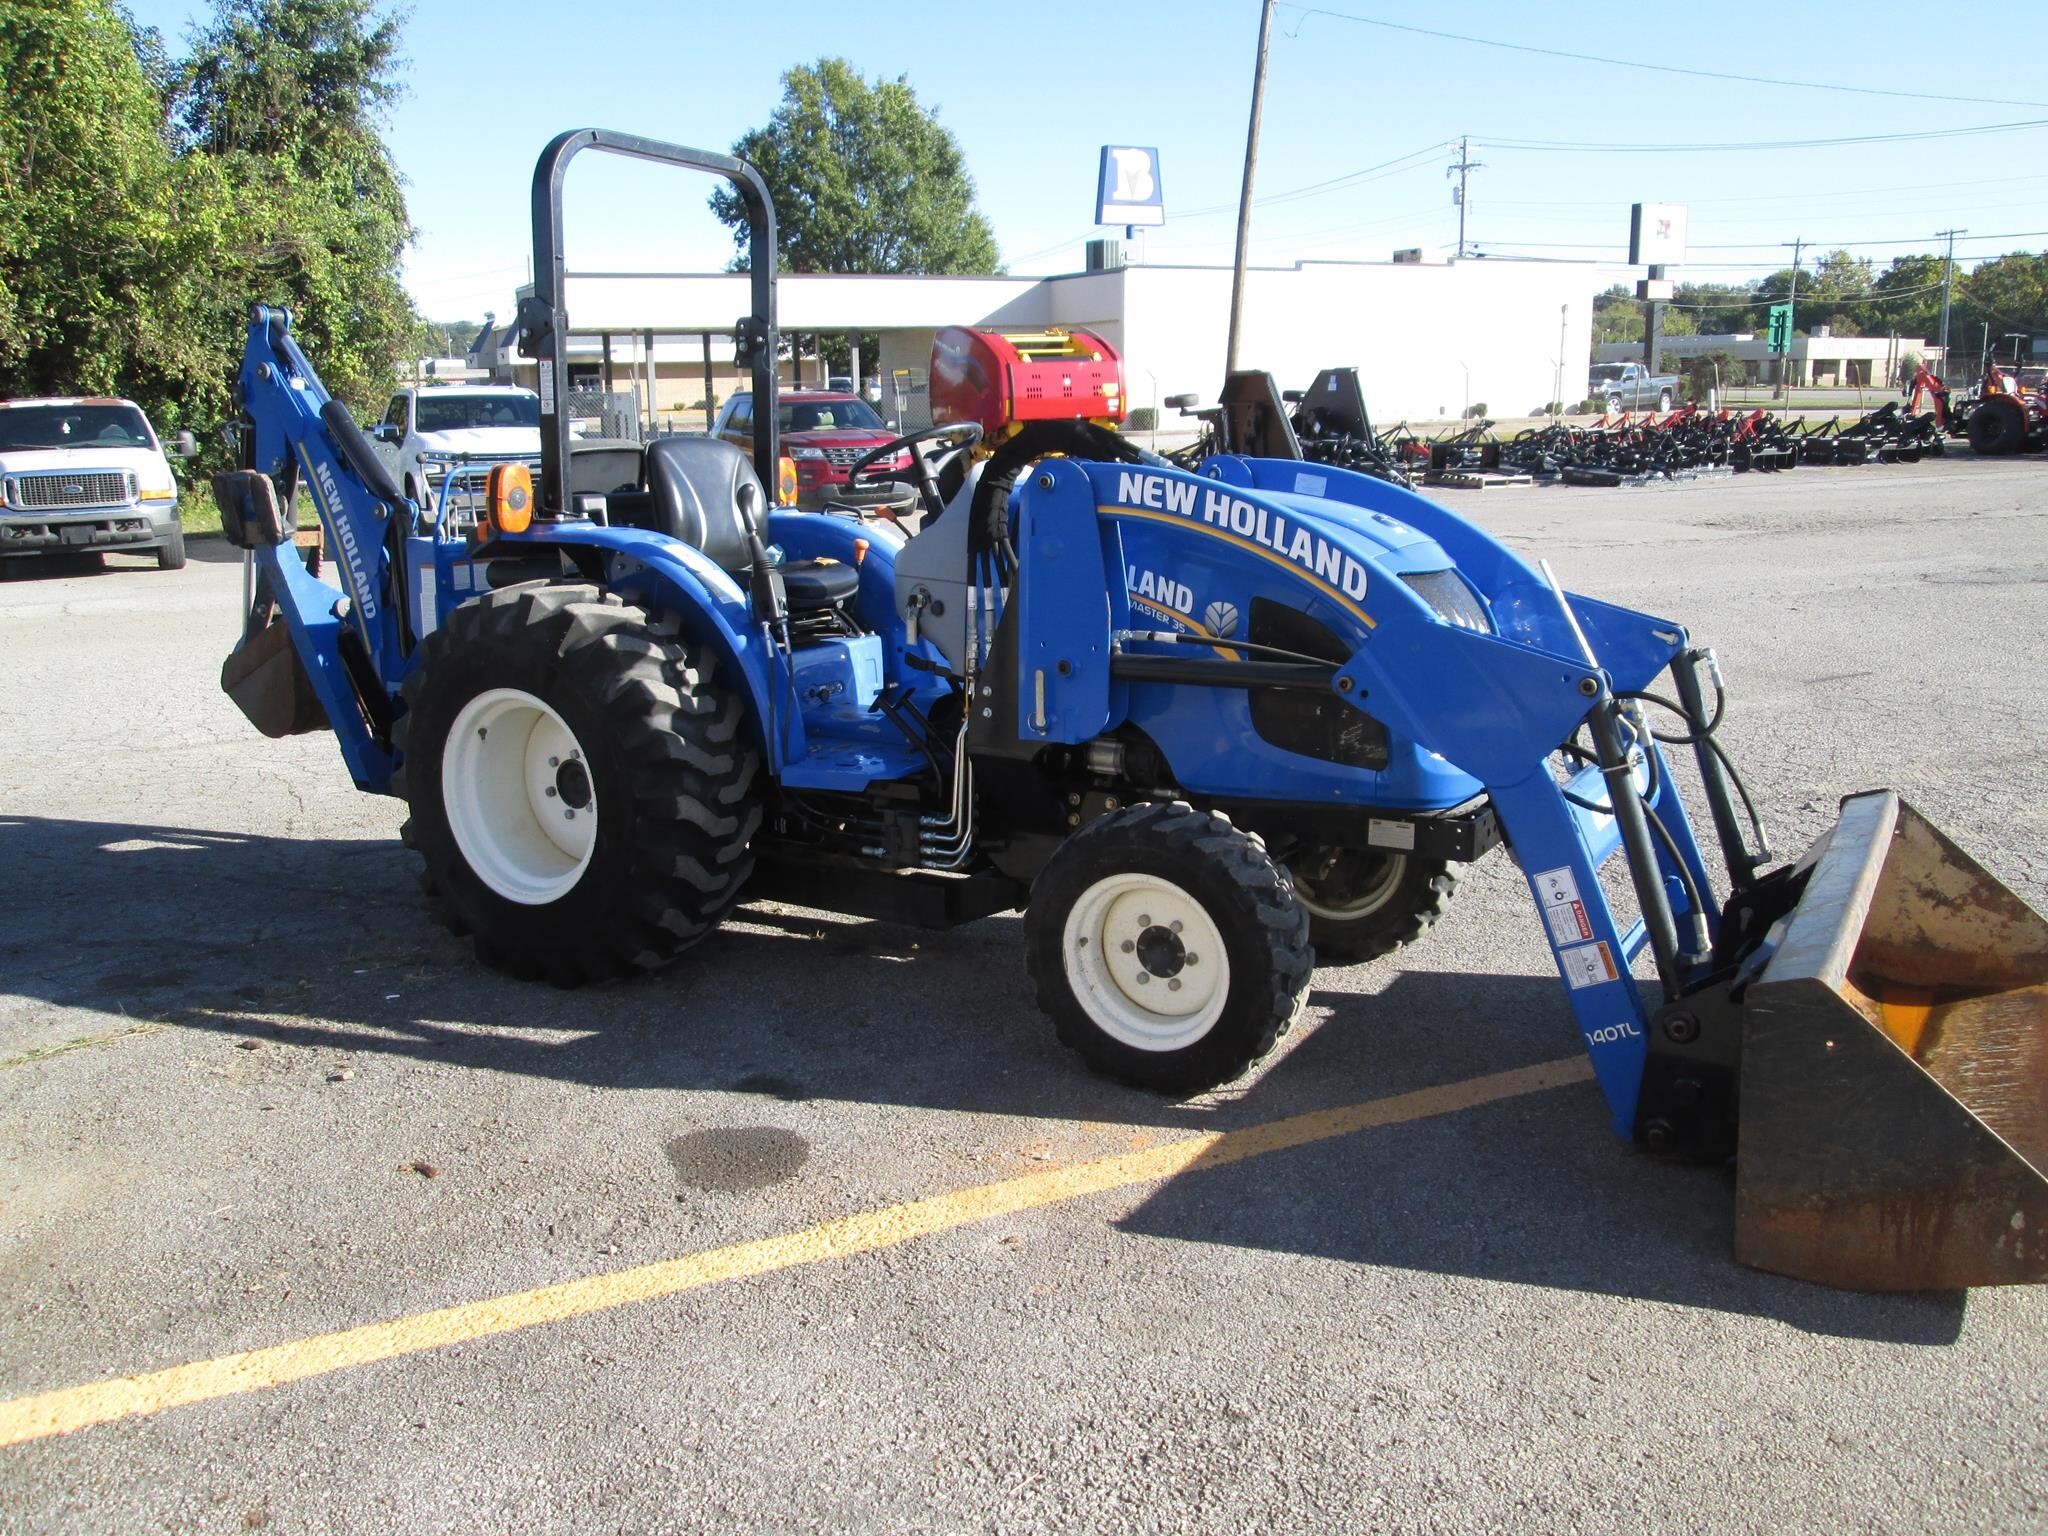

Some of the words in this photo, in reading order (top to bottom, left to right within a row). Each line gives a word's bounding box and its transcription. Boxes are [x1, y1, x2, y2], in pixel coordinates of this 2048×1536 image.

[317, 461, 343, 513] NEW
[336, 515, 376, 619] HOLLAND
[1118, 472, 1198, 516] NEW
[1204, 490, 1367, 602] HOLLAND
[1128, 564, 1193, 614] LAND
[1172, 619, 1186, 633] 35
